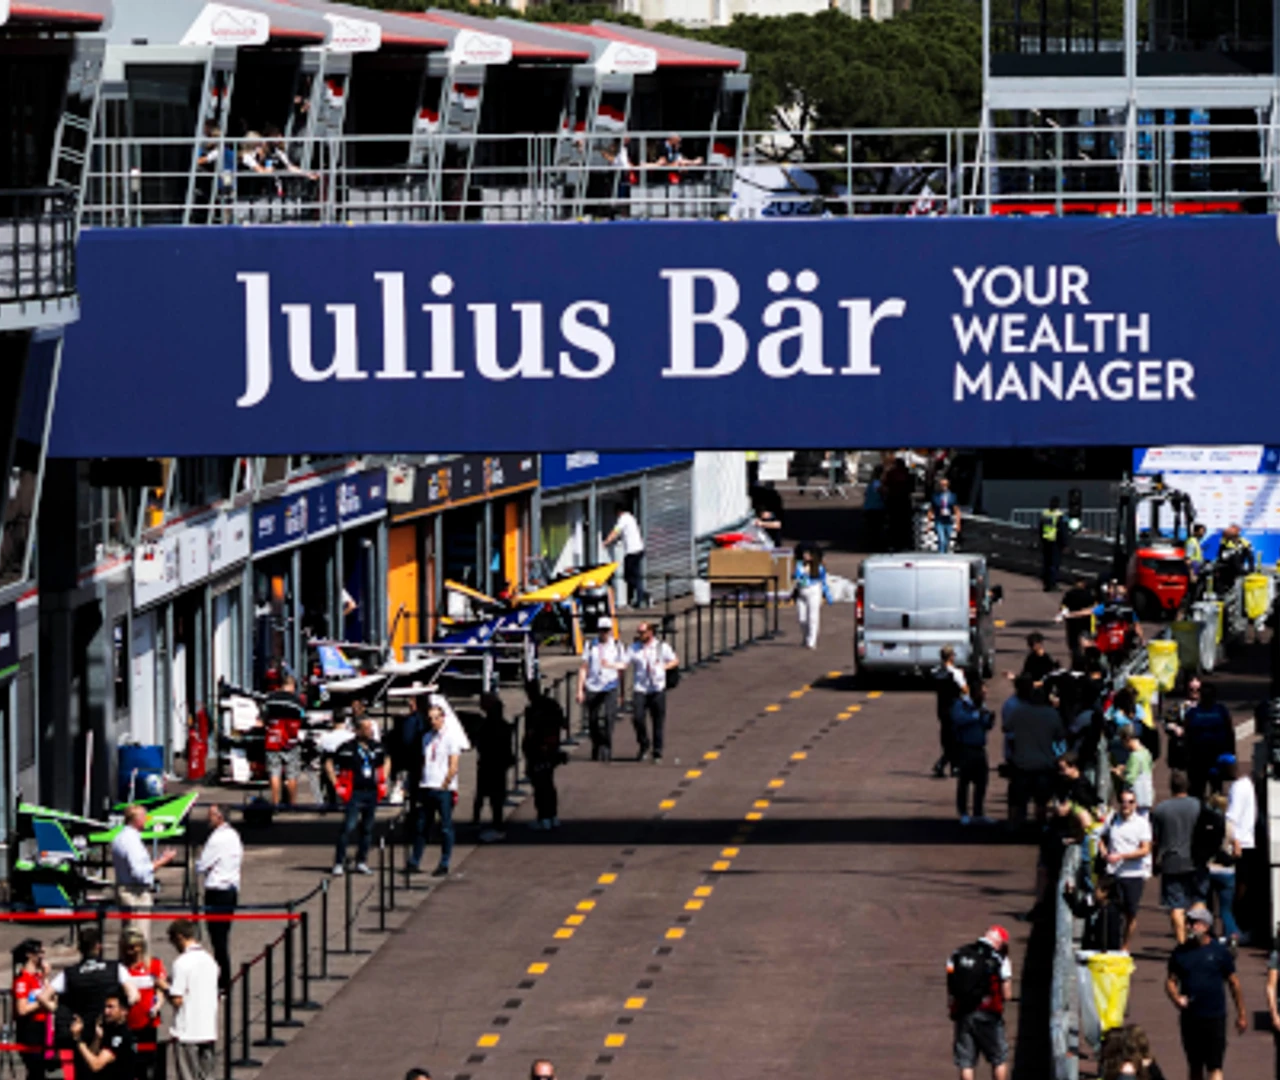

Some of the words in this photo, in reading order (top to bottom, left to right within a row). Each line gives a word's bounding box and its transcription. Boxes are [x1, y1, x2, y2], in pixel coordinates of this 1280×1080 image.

[952, 265, 1090, 307] YOUR
[236, 271, 615, 407] Julius
[659, 268, 907, 378] Bär
[952, 313, 1149, 355] WEALTH
[954, 359, 1195, 401] MANAGER
